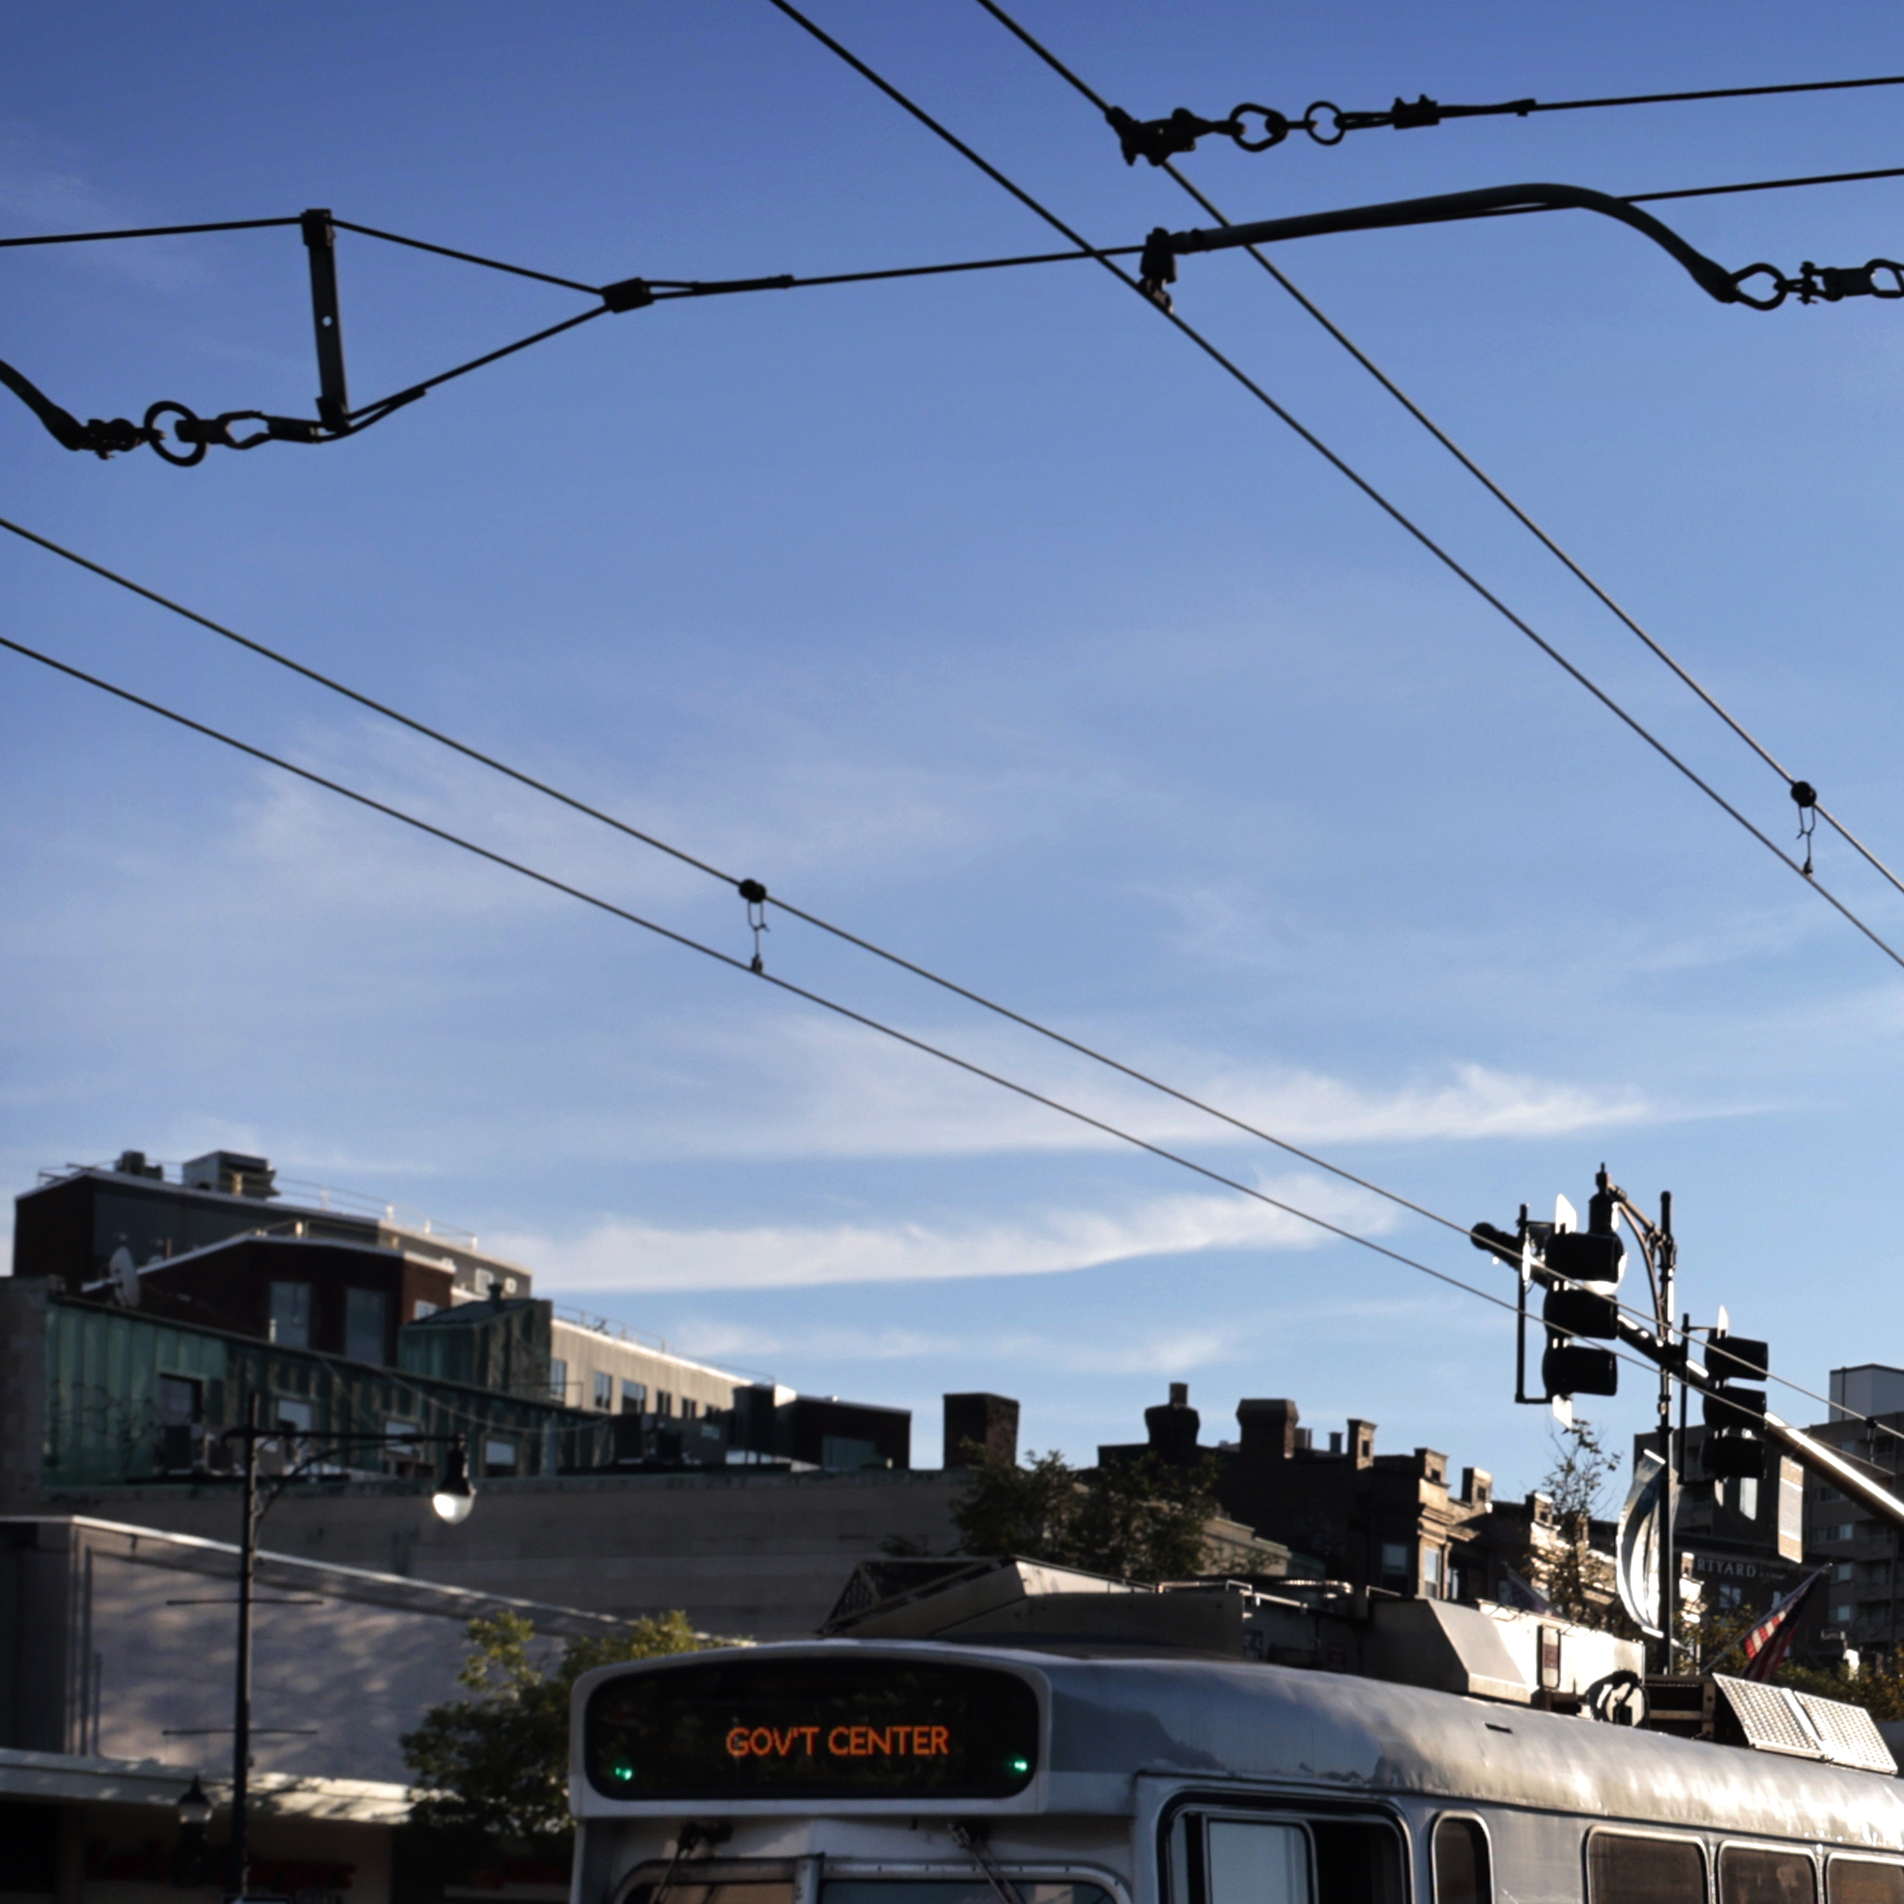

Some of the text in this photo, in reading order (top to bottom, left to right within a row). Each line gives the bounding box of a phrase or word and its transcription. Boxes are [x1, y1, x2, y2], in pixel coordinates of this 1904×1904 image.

[1696, 1557, 1757, 1578] RTYARD
[725, 1725, 951, 1757] GOV'T CENTER
